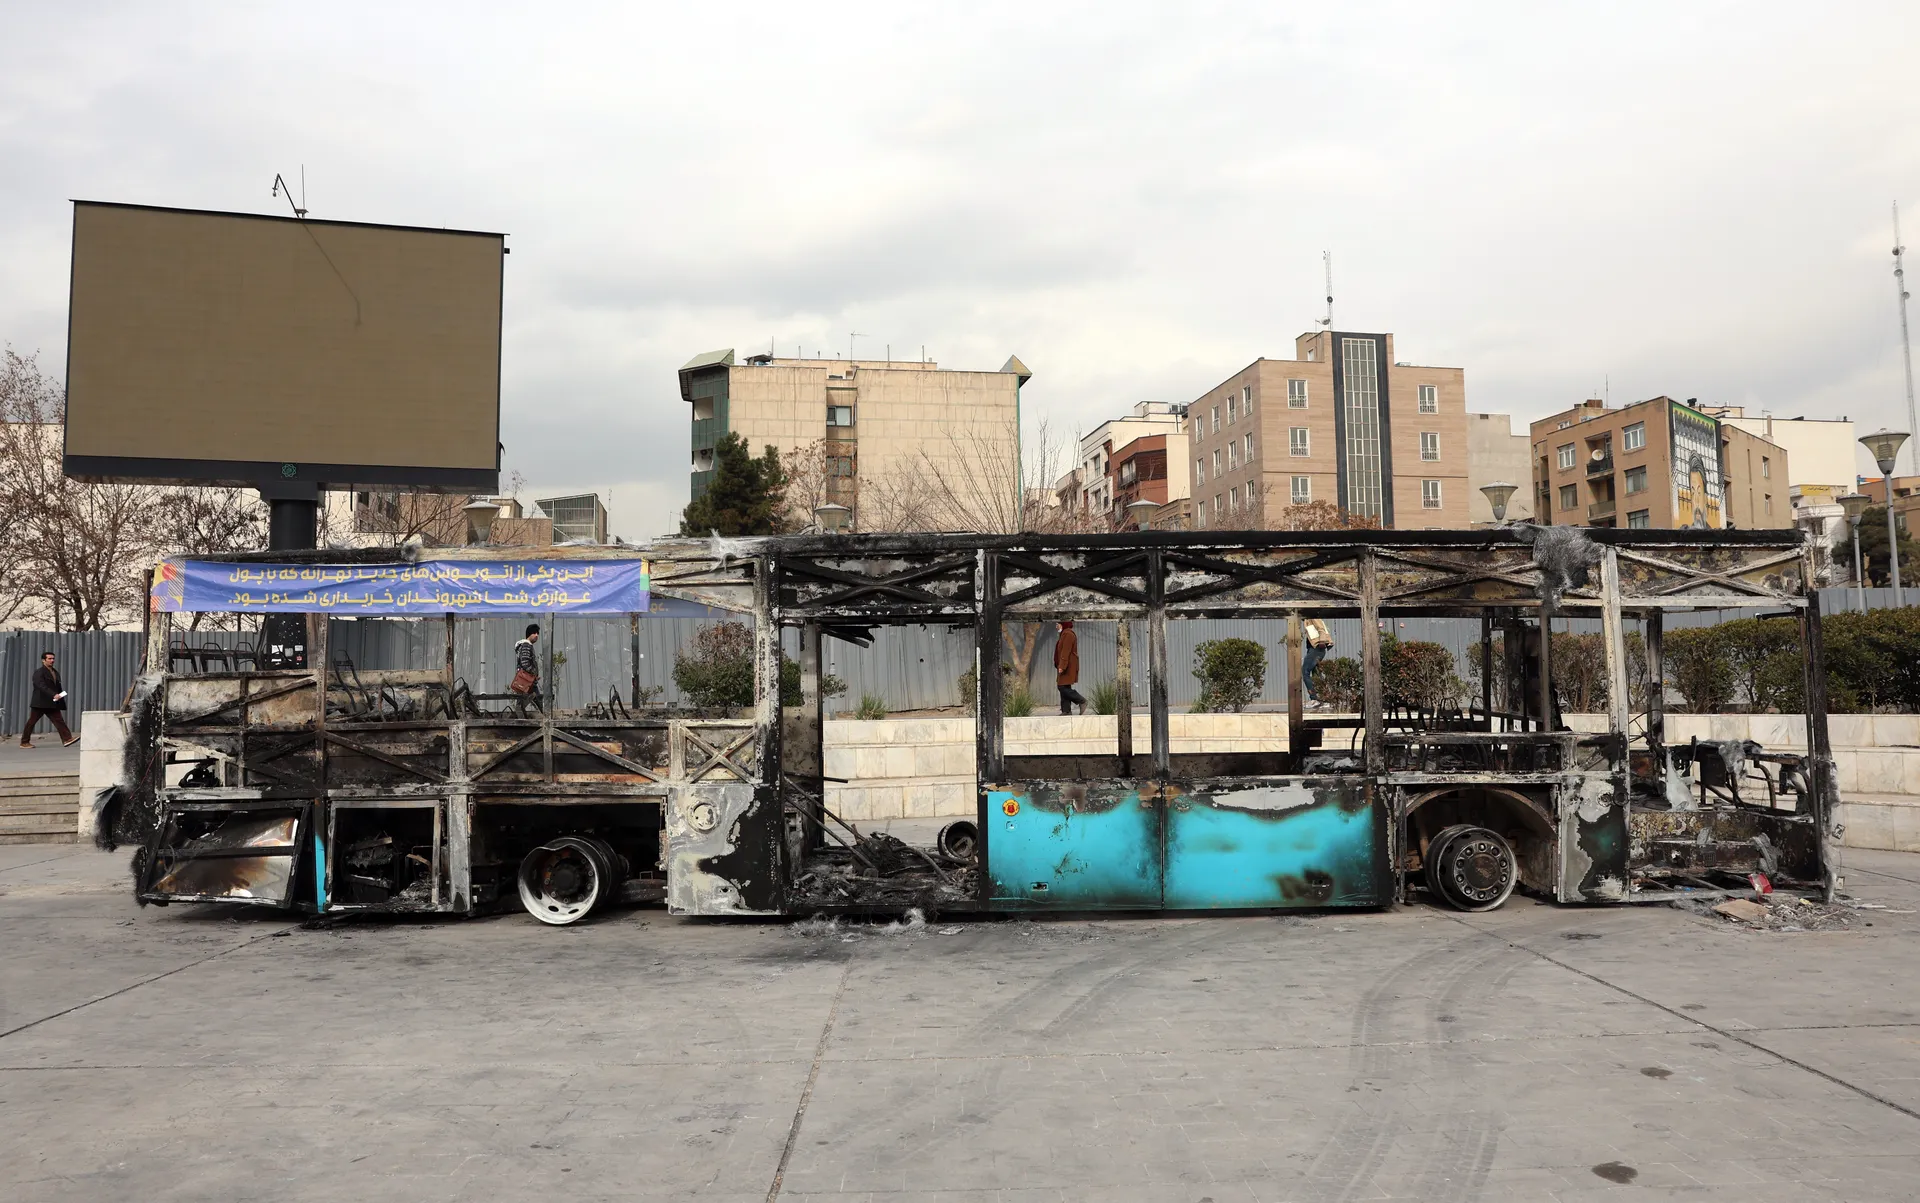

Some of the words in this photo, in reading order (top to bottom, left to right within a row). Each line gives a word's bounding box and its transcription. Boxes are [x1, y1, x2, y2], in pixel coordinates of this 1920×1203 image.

[229, 567, 265, 585] پول
[266, 568, 277, 584] با
[278, 567, 298, 581] که
[300, 566, 351, 583] تهرانه
[354, 567, 398, 583] جدید
[514, 565, 525, 582] از
[527, 565, 554, 582] یکی
[557, 565, 594, 582] این
[228, 592, 269, 608] بود.
[272, 590, 317, 605] شده
[319, 588, 394, 607] خریداری
[397, 588, 483, 608] شهروندان
[484, 589, 528, 604] شما
[530, 588, 591, 607] عوارض
